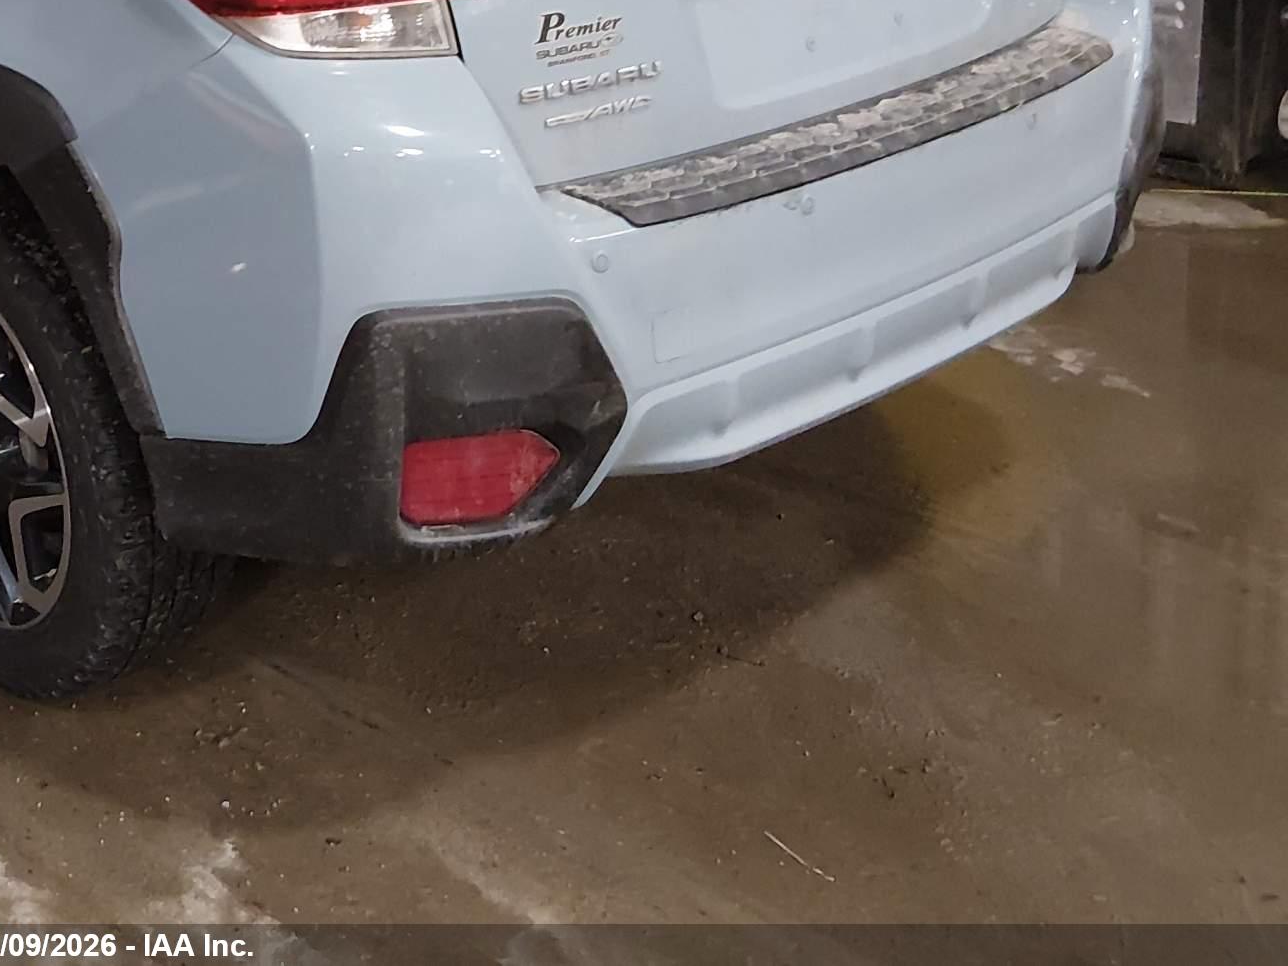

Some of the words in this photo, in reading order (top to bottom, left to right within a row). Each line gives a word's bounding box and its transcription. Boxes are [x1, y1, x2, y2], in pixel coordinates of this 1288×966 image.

[534, 12, 623, 45] Premier
[535, 40, 601, 60] SUBARU
[518, 60, 662, 105] SUBARU
